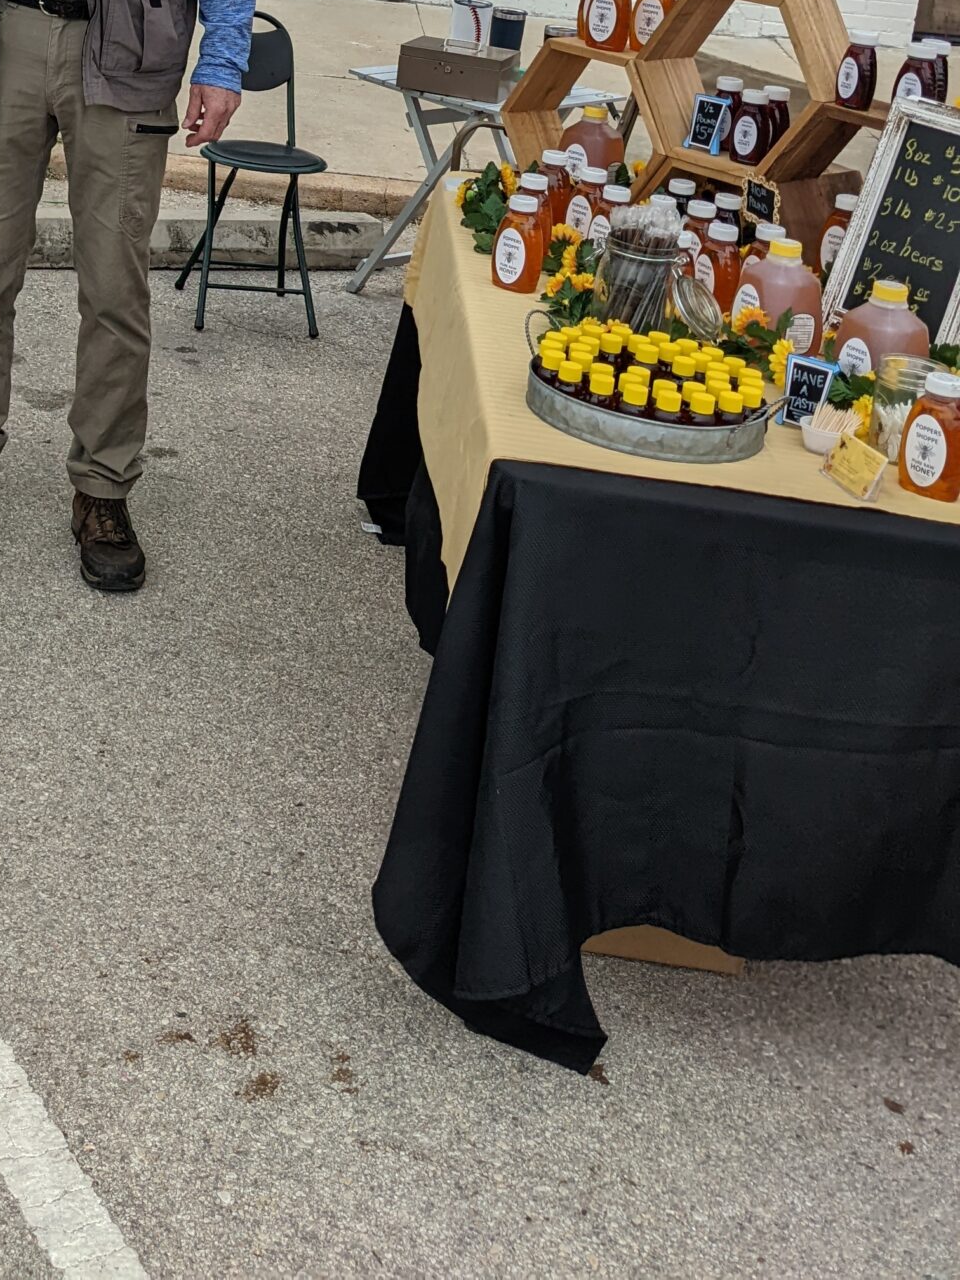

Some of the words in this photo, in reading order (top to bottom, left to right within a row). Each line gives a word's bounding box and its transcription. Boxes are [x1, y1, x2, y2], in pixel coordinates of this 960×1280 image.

[498, 267, 518, 276] HONEY
[845, 351, 865, 363] SHOPPE
[846, 343, 868, 357] POPPERS
[793, 367, 825, 388] HAVE
[800, 384, 808, 396] A
[915, 422, 942, 437] POPPERS
[916, 431, 938, 445] SHOPPE
[910, 463, 936, 478] HONEY
